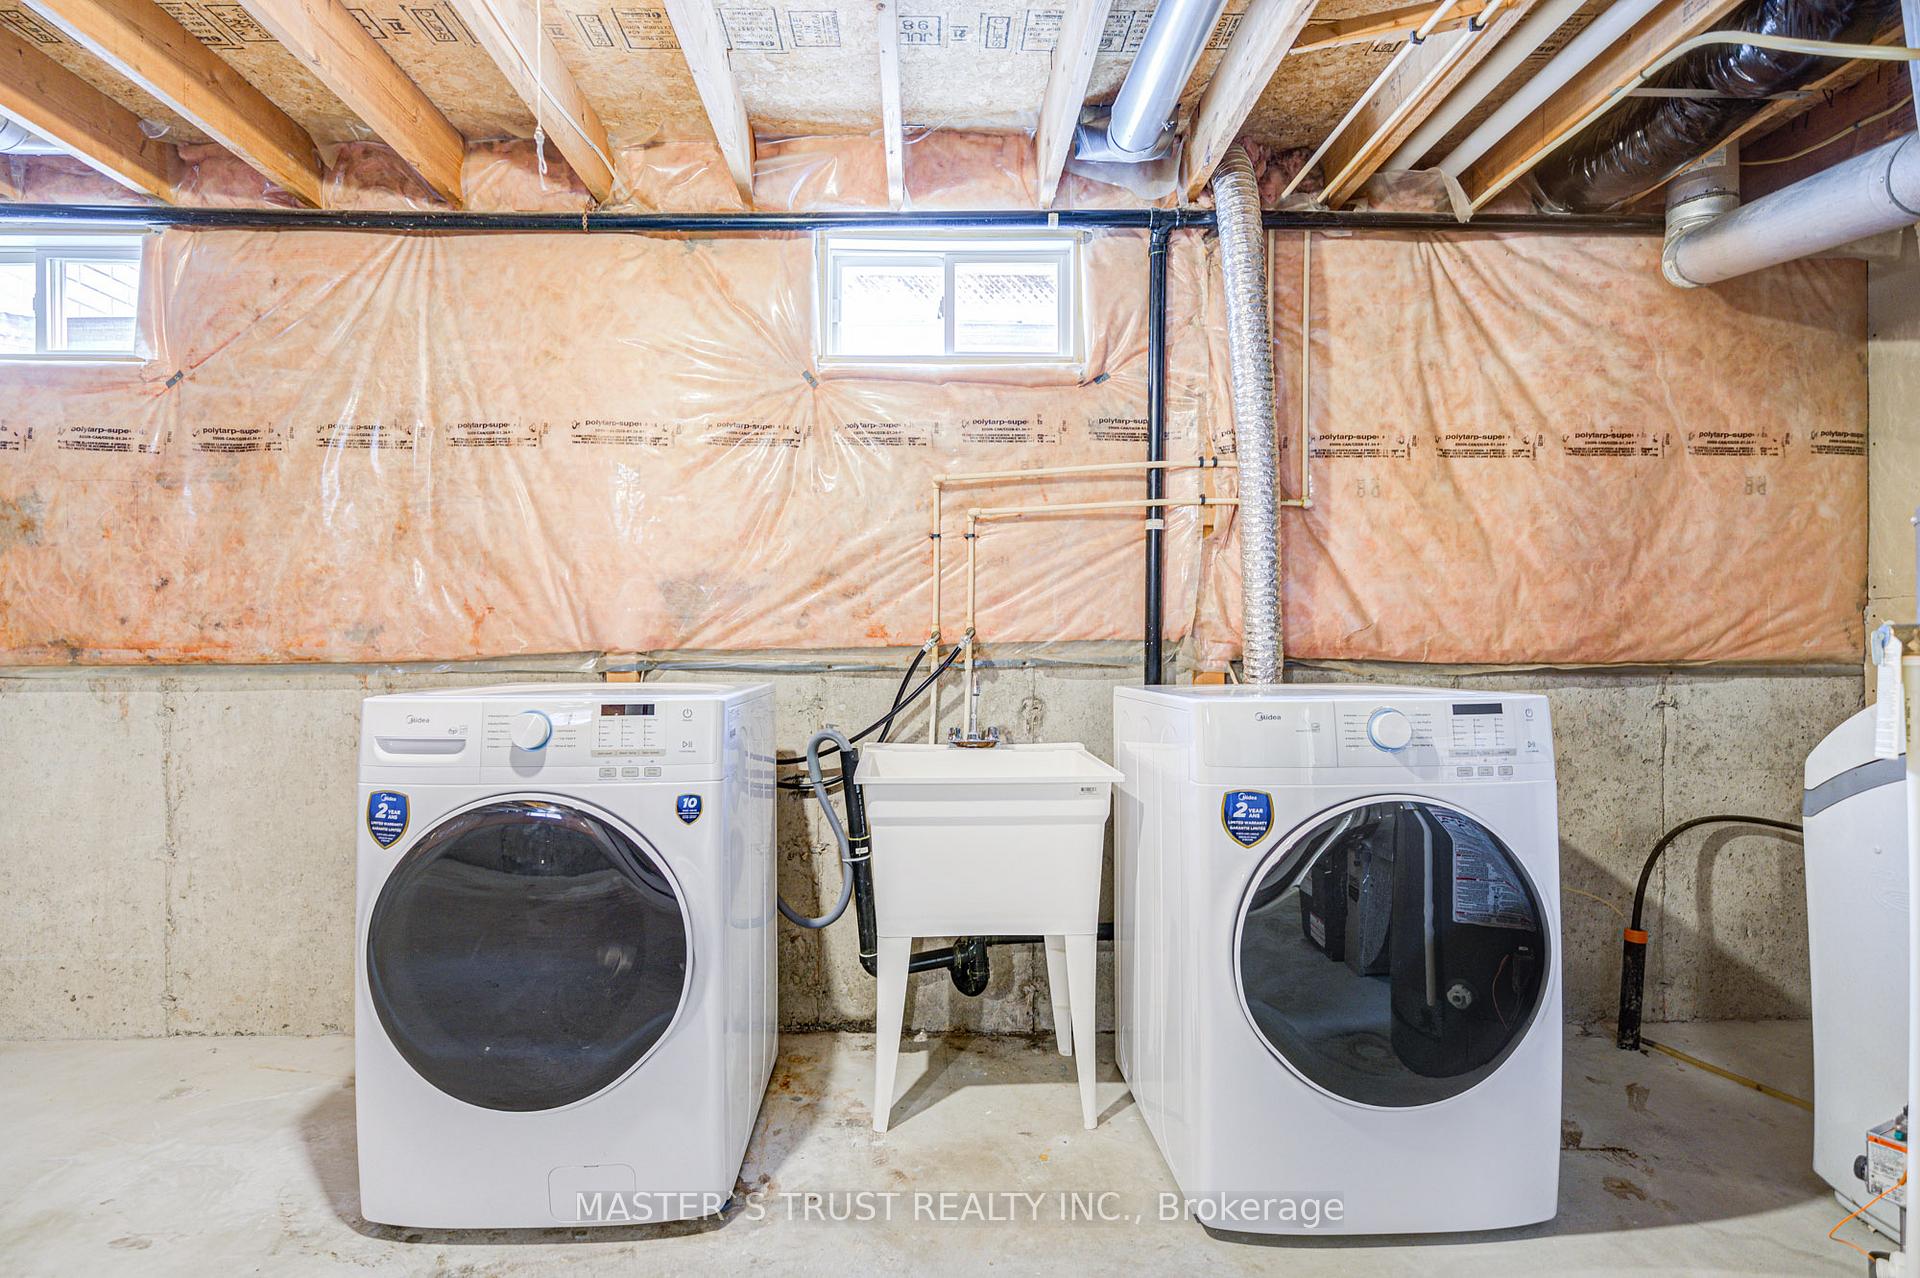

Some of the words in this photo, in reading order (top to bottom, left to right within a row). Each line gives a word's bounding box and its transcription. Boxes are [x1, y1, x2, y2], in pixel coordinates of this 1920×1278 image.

[899, 32, 933, 42] JUL
[1209, 17, 1230, 48] CANADA
[1820, 430, 1865, 439] polytarp-supe
[407, 714, 430, 725] Midea
[1254, 711, 1282, 722] Midea
[380, 793, 397, 802] Midea
[1238, 792, 1257, 801] Midea
[682, 797, 698, 809] 10
[375, 802, 389, 819] 2
[1233, 801, 1249, 818] 2
